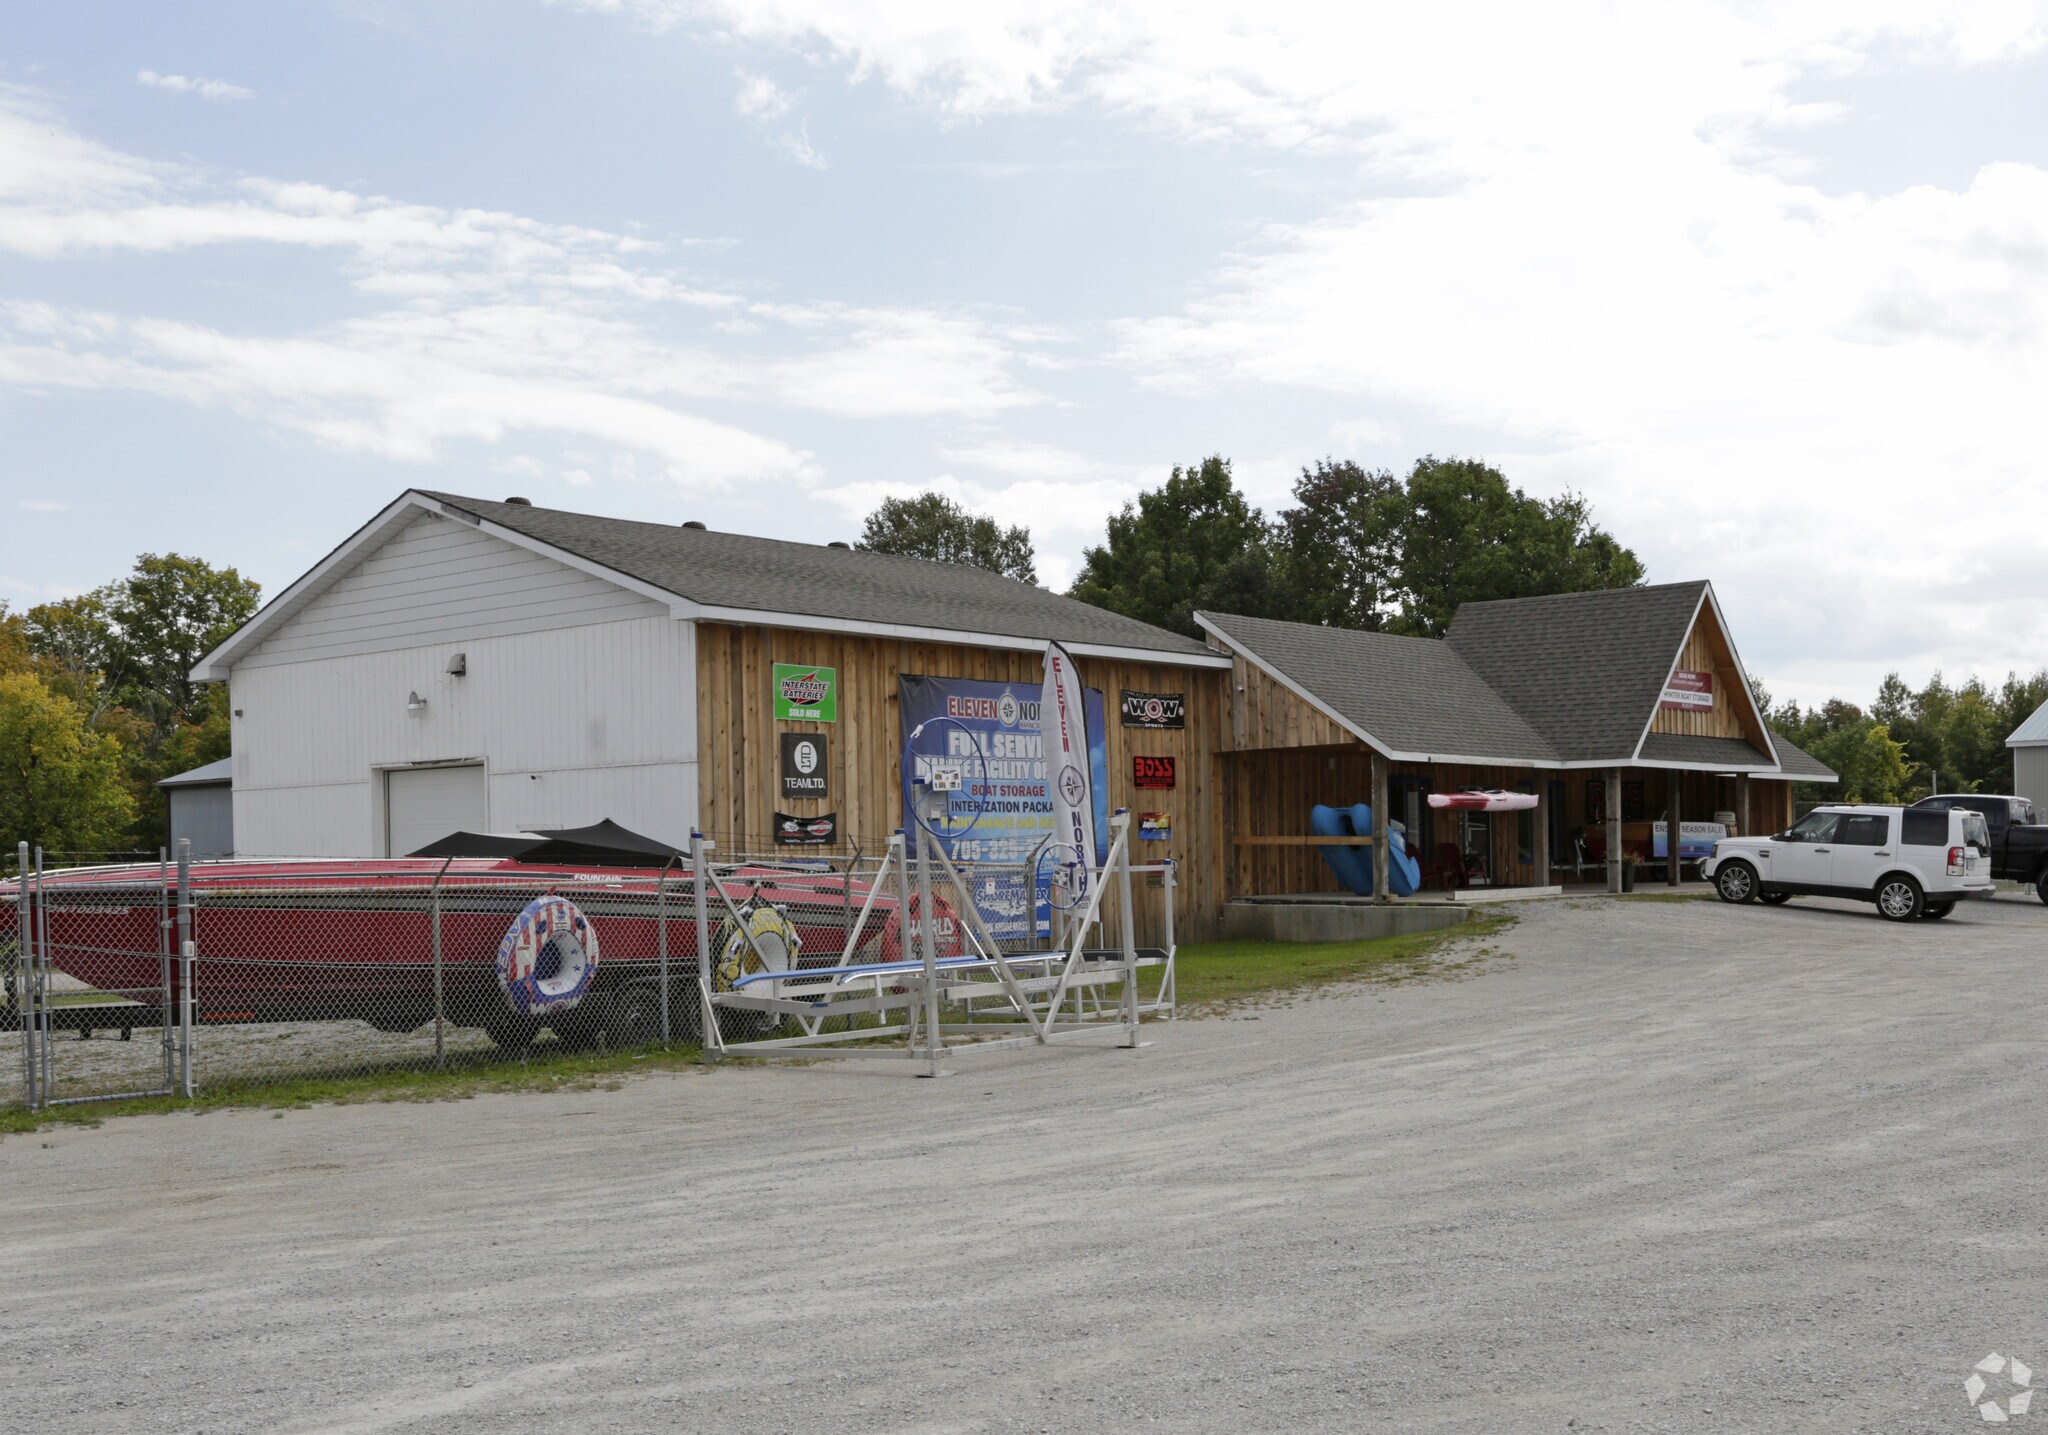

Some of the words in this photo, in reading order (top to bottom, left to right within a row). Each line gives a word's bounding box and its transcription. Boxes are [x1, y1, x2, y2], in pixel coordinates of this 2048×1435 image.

[782, 681, 827, 690] INTERSTATE
[784, 690, 824, 699] BATTERIES
[1664, 692, 1680, 700] WINTER
[1681, 693, 1692, 701] BOAT
[1692, 694, 1710, 702] STORAGE
[948, 697, 998, 719] ELEVEN
[1052, 656, 1069, 753] ELEVEN
[1128, 698, 1179, 719] WOW
[789, 708, 805, 717] SOLD
[805, 709, 821, 718] HERE
[950, 731, 991, 757] FULL
[993, 733, 1045, 759] SERVI
[974, 759, 1031, 781] FACILITY
[1136, 757, 1173, 777] BOSS
[971, 784, 997, 796] BOAT
[1000, 785, 1045, 797] STORAGE
[951, 801, 1021, 813] INTERZATION
[1017, 817, 1037, 829] AND
[1681, 825, 1706, 833] SEASON
[573, 873, 622, 881] FOUNTAIN
[976, 887, 1048, 903] SHOREMAER
